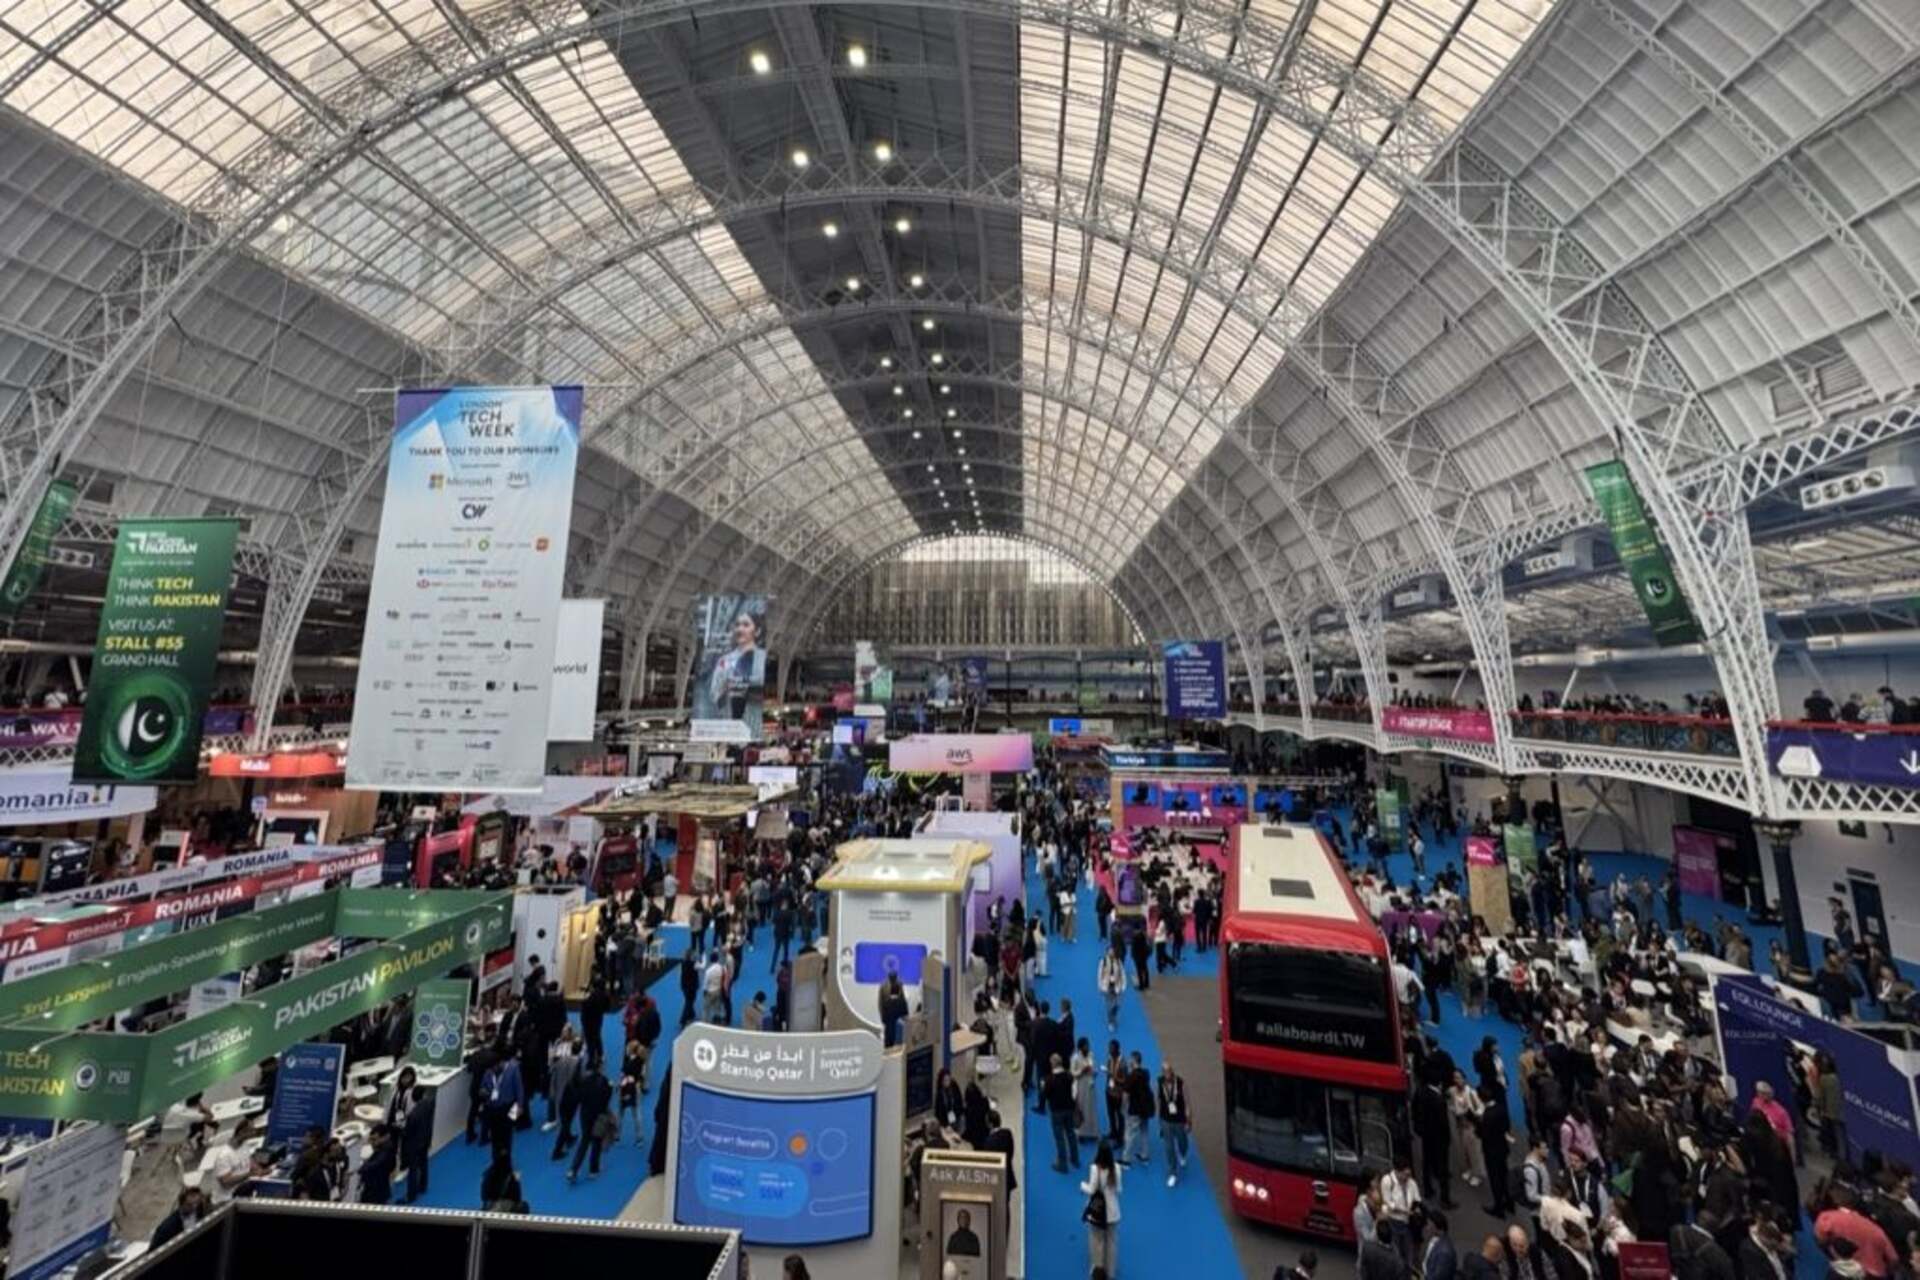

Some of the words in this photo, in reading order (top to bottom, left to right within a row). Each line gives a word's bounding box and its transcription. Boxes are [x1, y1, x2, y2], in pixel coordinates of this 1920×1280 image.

[461, 411, 502, 424] TECH
[469, 424, 514, 438] WEEK
[409, 446, 442, 456] THANK
[446, 446, 466, 456] YOU
[469, 446, 481, 456] TO
[483, 446, 504, 456] OUR
[115, 577, 154, 590] THINK
[156, 577, 194, 590] TECH
[113, 594, 150, 606] THINK
[152, 593, 221, 607] PAKISTAN
[108, 618, 137, 632] VISIT
[138, 618, 156, 632] US
[104, 636, 150, 649] STALL
[154, 636, 185, 651] #55
[101, 653, 147, 667] GRAND
[148, 653, 179, 667] HALL
[552, 662, 588, 674] world
[31, 722, 68, 736] WAY
[946, 748, 973, 762] aws
[224, 850, 290, 873] ROMANIA
[319, 852, 379, 876] ROMANIA
[154, 885, 244, 920] ROMANIA
[116, 943, 228, 987] English-Speaking
[229, 930, 263, 949] Nation
[273, 967, 378, 1030] PAKISTAN
[377, 936, 455, 983] PAVILION
[1256, 1021, 1366, 1049] #allaboardLTW
[5, 1050, 50, 1070] TECH
[719, 1061, 764, 1082] Startup
[766, 1066, 803, 1082] Qatar
[929, 1167, 954, 1181] Ask
